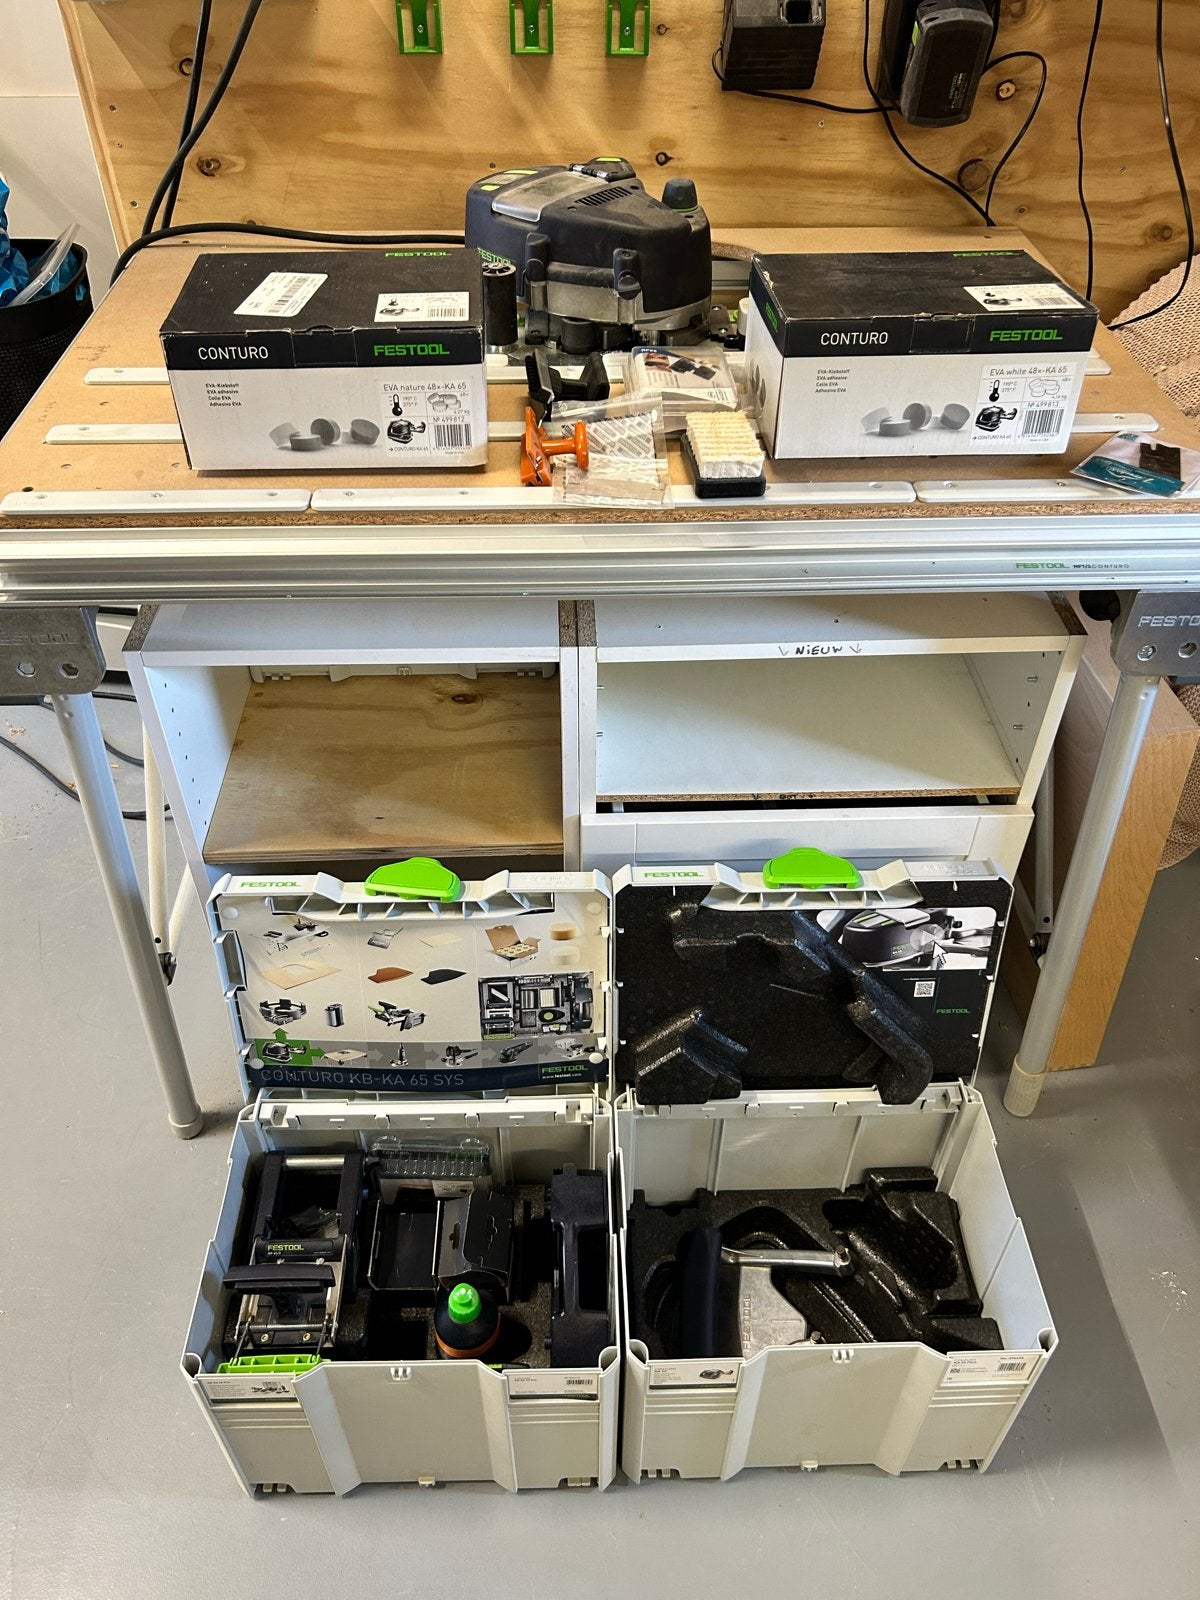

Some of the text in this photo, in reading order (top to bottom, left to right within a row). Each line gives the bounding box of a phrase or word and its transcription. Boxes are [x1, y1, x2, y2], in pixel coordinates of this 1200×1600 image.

[820, 331, 889, 346] CONTURO
[989, 328, 1063, 342] FESTOOL
[198, 346, 269, 360] CONTURO
[373, 343, 450, 357] FESTOOL
[990, 368, 1005, 376] EVA
[1006, 367, 1027, 375] white
[1058, 365, 1067, 374] 65
[383, 384, 398, 392] EVA
[400, 383, 425, 391] nature
[457, 381, 467, 390] 65
[1015, 561, 1070, 569] FESTOOL
[541, 1064, 588, 1074] FESTOOL
[260, 1069, 465, 1087] CONTURO KB-KA 65 SYS
